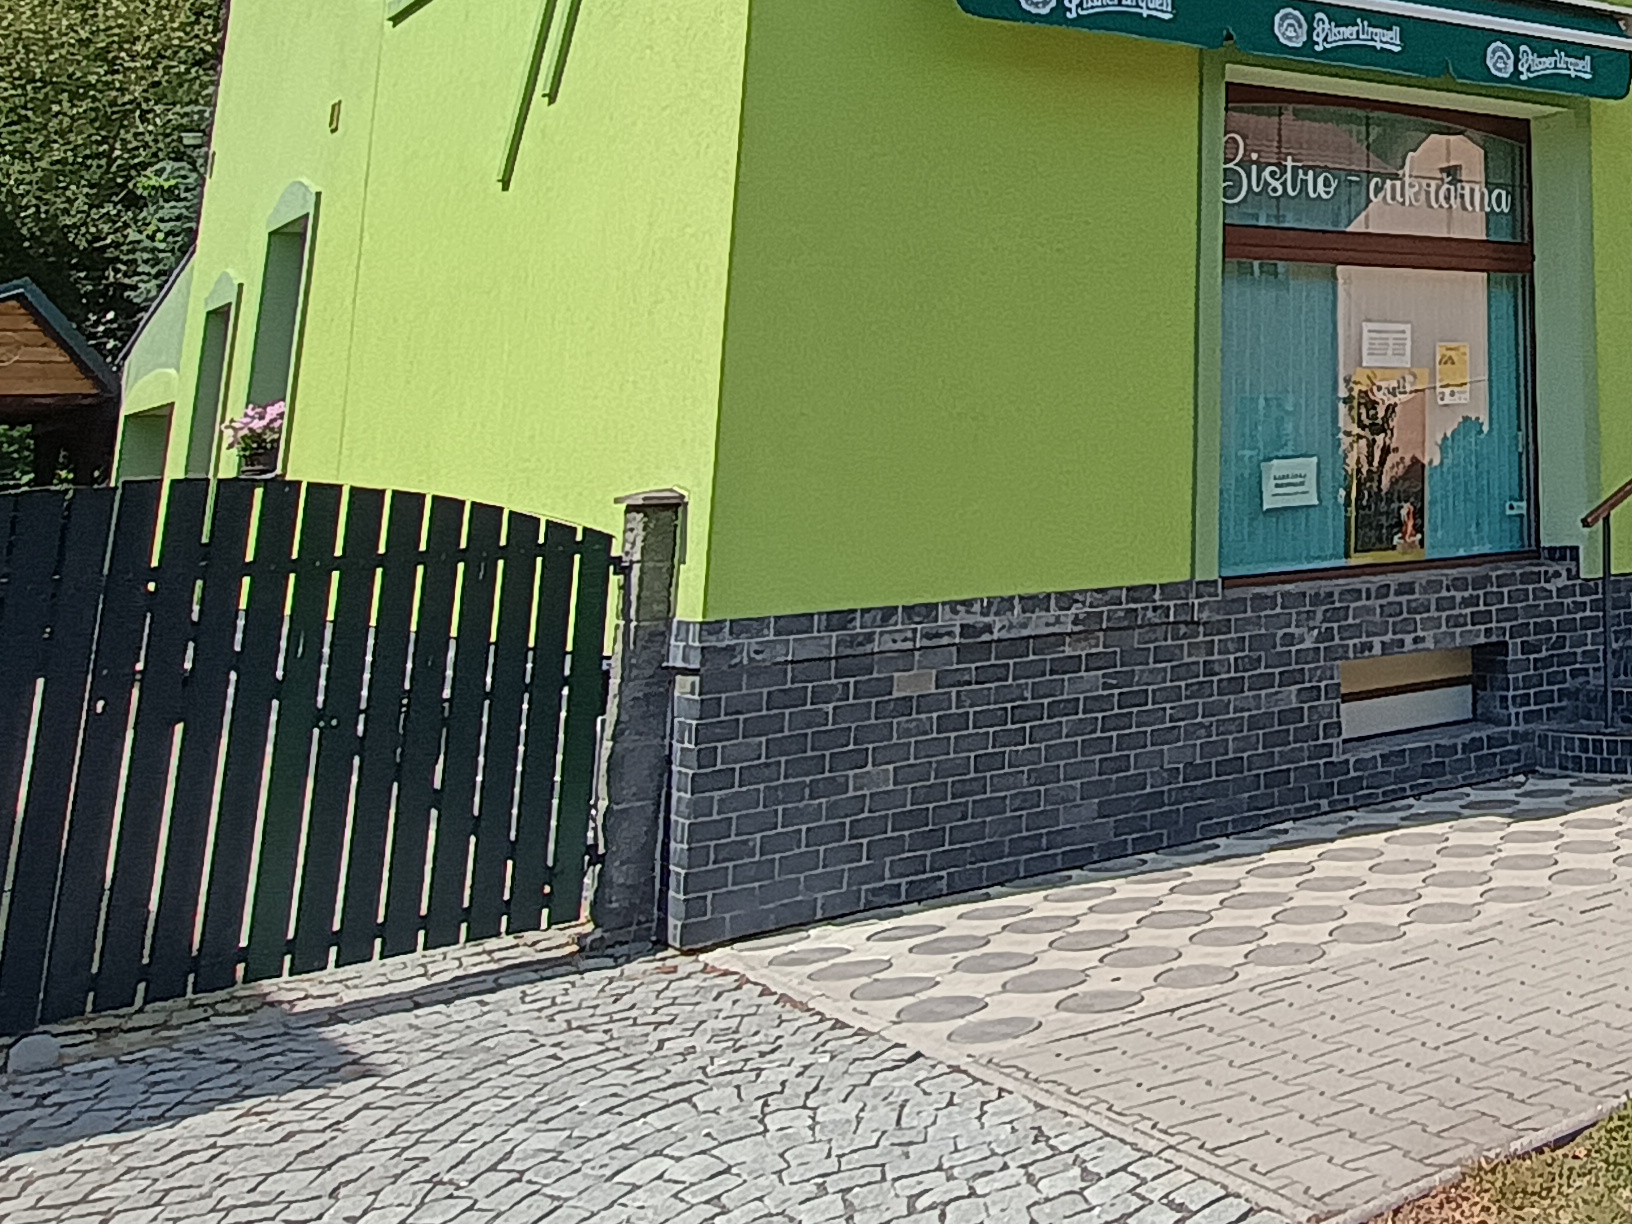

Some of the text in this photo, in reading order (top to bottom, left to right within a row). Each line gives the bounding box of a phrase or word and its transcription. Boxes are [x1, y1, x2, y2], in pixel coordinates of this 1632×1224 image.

[1312, 12, 1359, 51] Pilsner
[1222, 133, 1338, 204] Bistro
[1368, 152, 1512, 213] cukrárna
